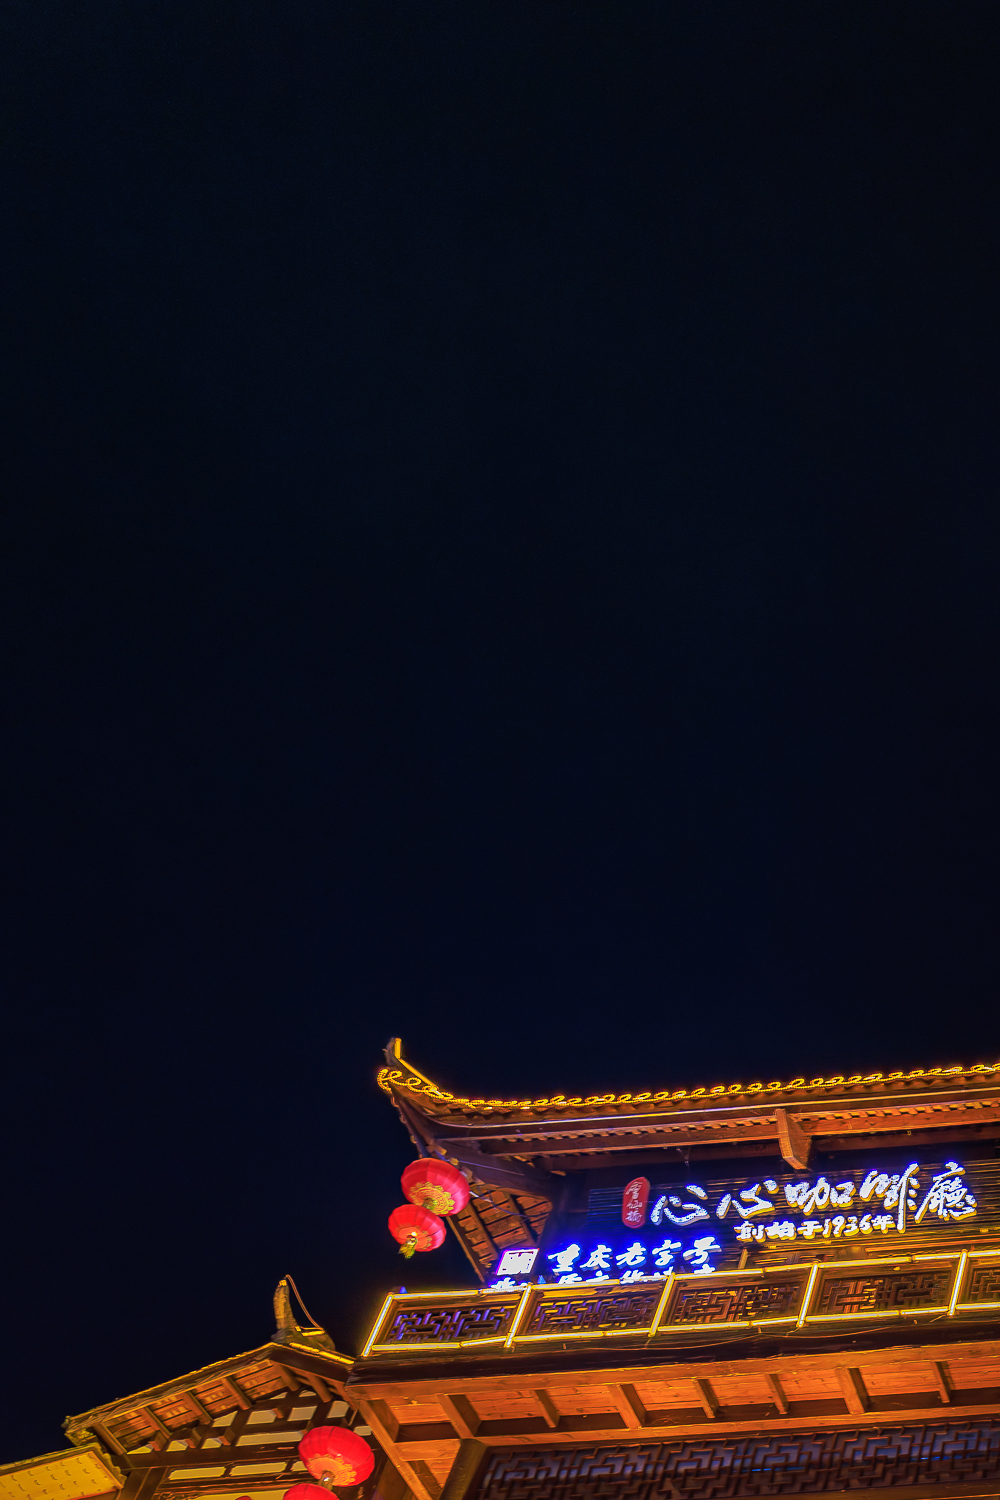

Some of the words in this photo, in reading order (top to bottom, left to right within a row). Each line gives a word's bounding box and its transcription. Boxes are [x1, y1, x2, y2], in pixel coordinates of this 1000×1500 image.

[547, 1236, 722, 1273] 重庆老字号
